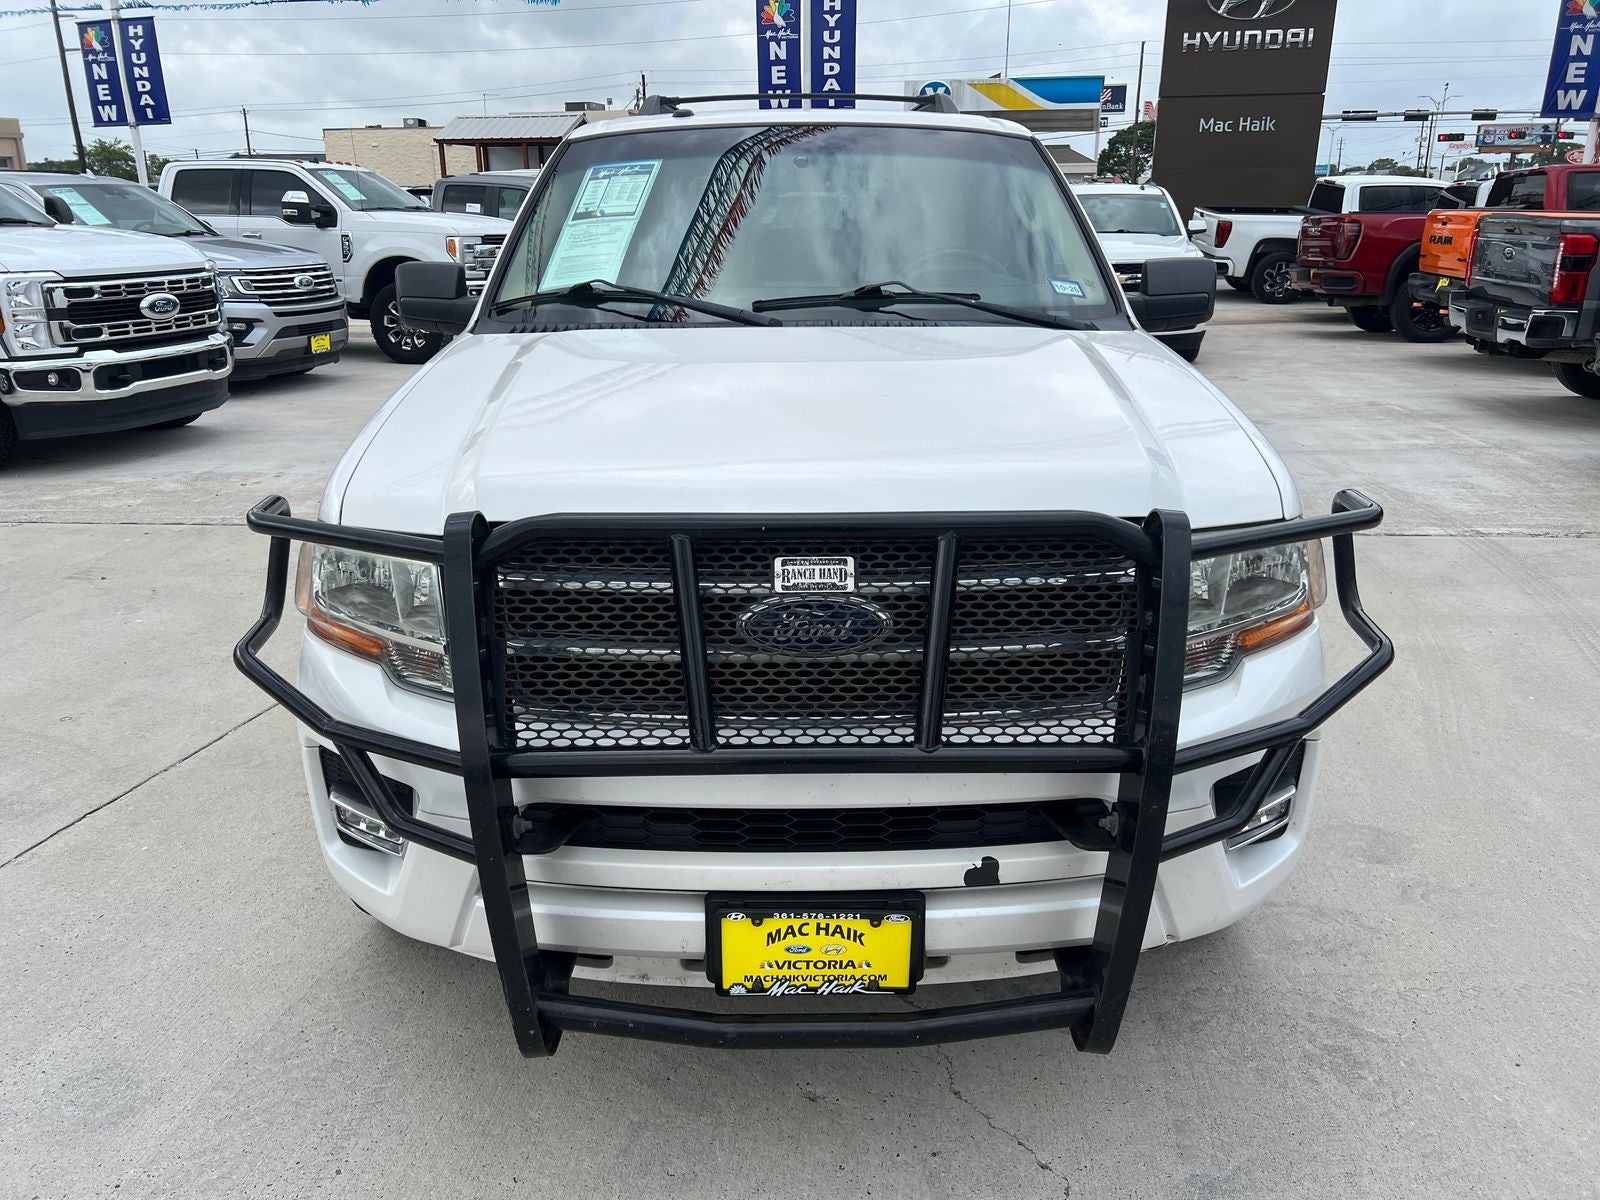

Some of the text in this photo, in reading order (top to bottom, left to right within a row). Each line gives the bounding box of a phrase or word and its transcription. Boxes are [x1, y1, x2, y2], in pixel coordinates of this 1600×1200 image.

[1182, 27, 1315, 53] HYUNDAI
[823, 0, 841, 107] HYUNDAI
[128, 25, 155, 119] HYUNDAI
[768, 41, 791, 108] NEW
[1557, 34, 1595, 110] NEW
[92, 63, 117, 121] NEW
[1199, 116, 1277, 133] Mac Haik
[1429, 235, 1453, 245] RAM
[154, 300, 174, 312] Ford
[781, 567, 848, 583] RANCH HAND
[773, 912, 861, 920] 361-576-1221
[766, 922, 866, 947] MAC HAIK
[788, 945, 808, 953] Ford
[774, 959, 857, 970] VICTORIA
[766, 980, 870, 997] Mac Haik
